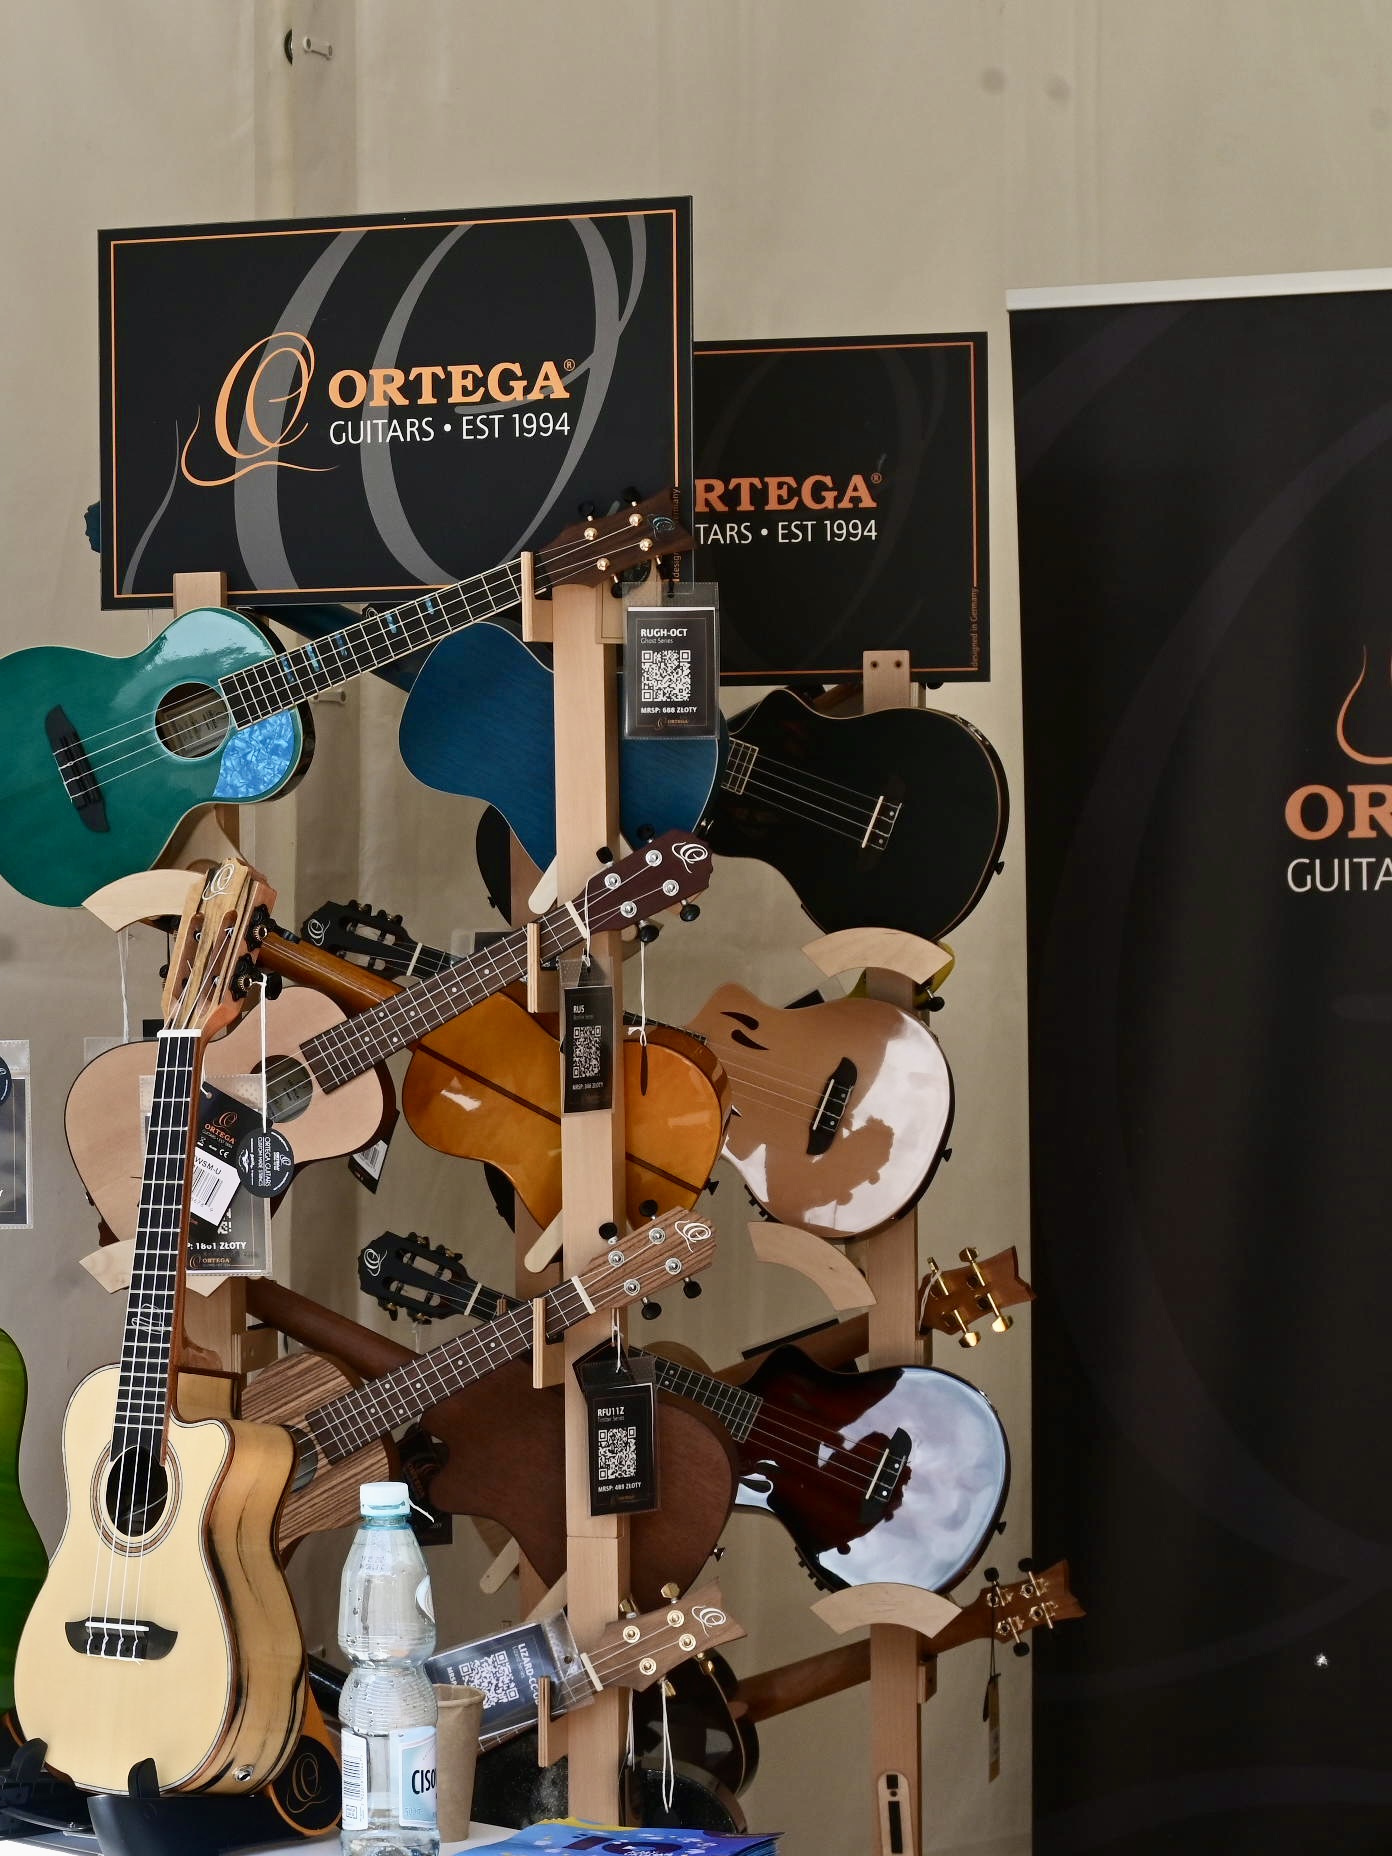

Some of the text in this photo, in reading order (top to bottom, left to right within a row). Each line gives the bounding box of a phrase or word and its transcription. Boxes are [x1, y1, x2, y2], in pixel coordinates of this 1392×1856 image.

[329, 412, 570, 445] GUITARS EST 1994
[695, 472, 882, 513] RTEGA®
[695, 519, 877, 544] TARS EST 1994
[640, 628, 688, 637] RUGH-OCT
[204, 1122, 236, 1146] ORTEGA
[263, 1136, 271, 1161] ORTEGA
[219, 1241, 247, 1250] ZŁOTY
[597, 1406, 625, 1417] RFU11Z
